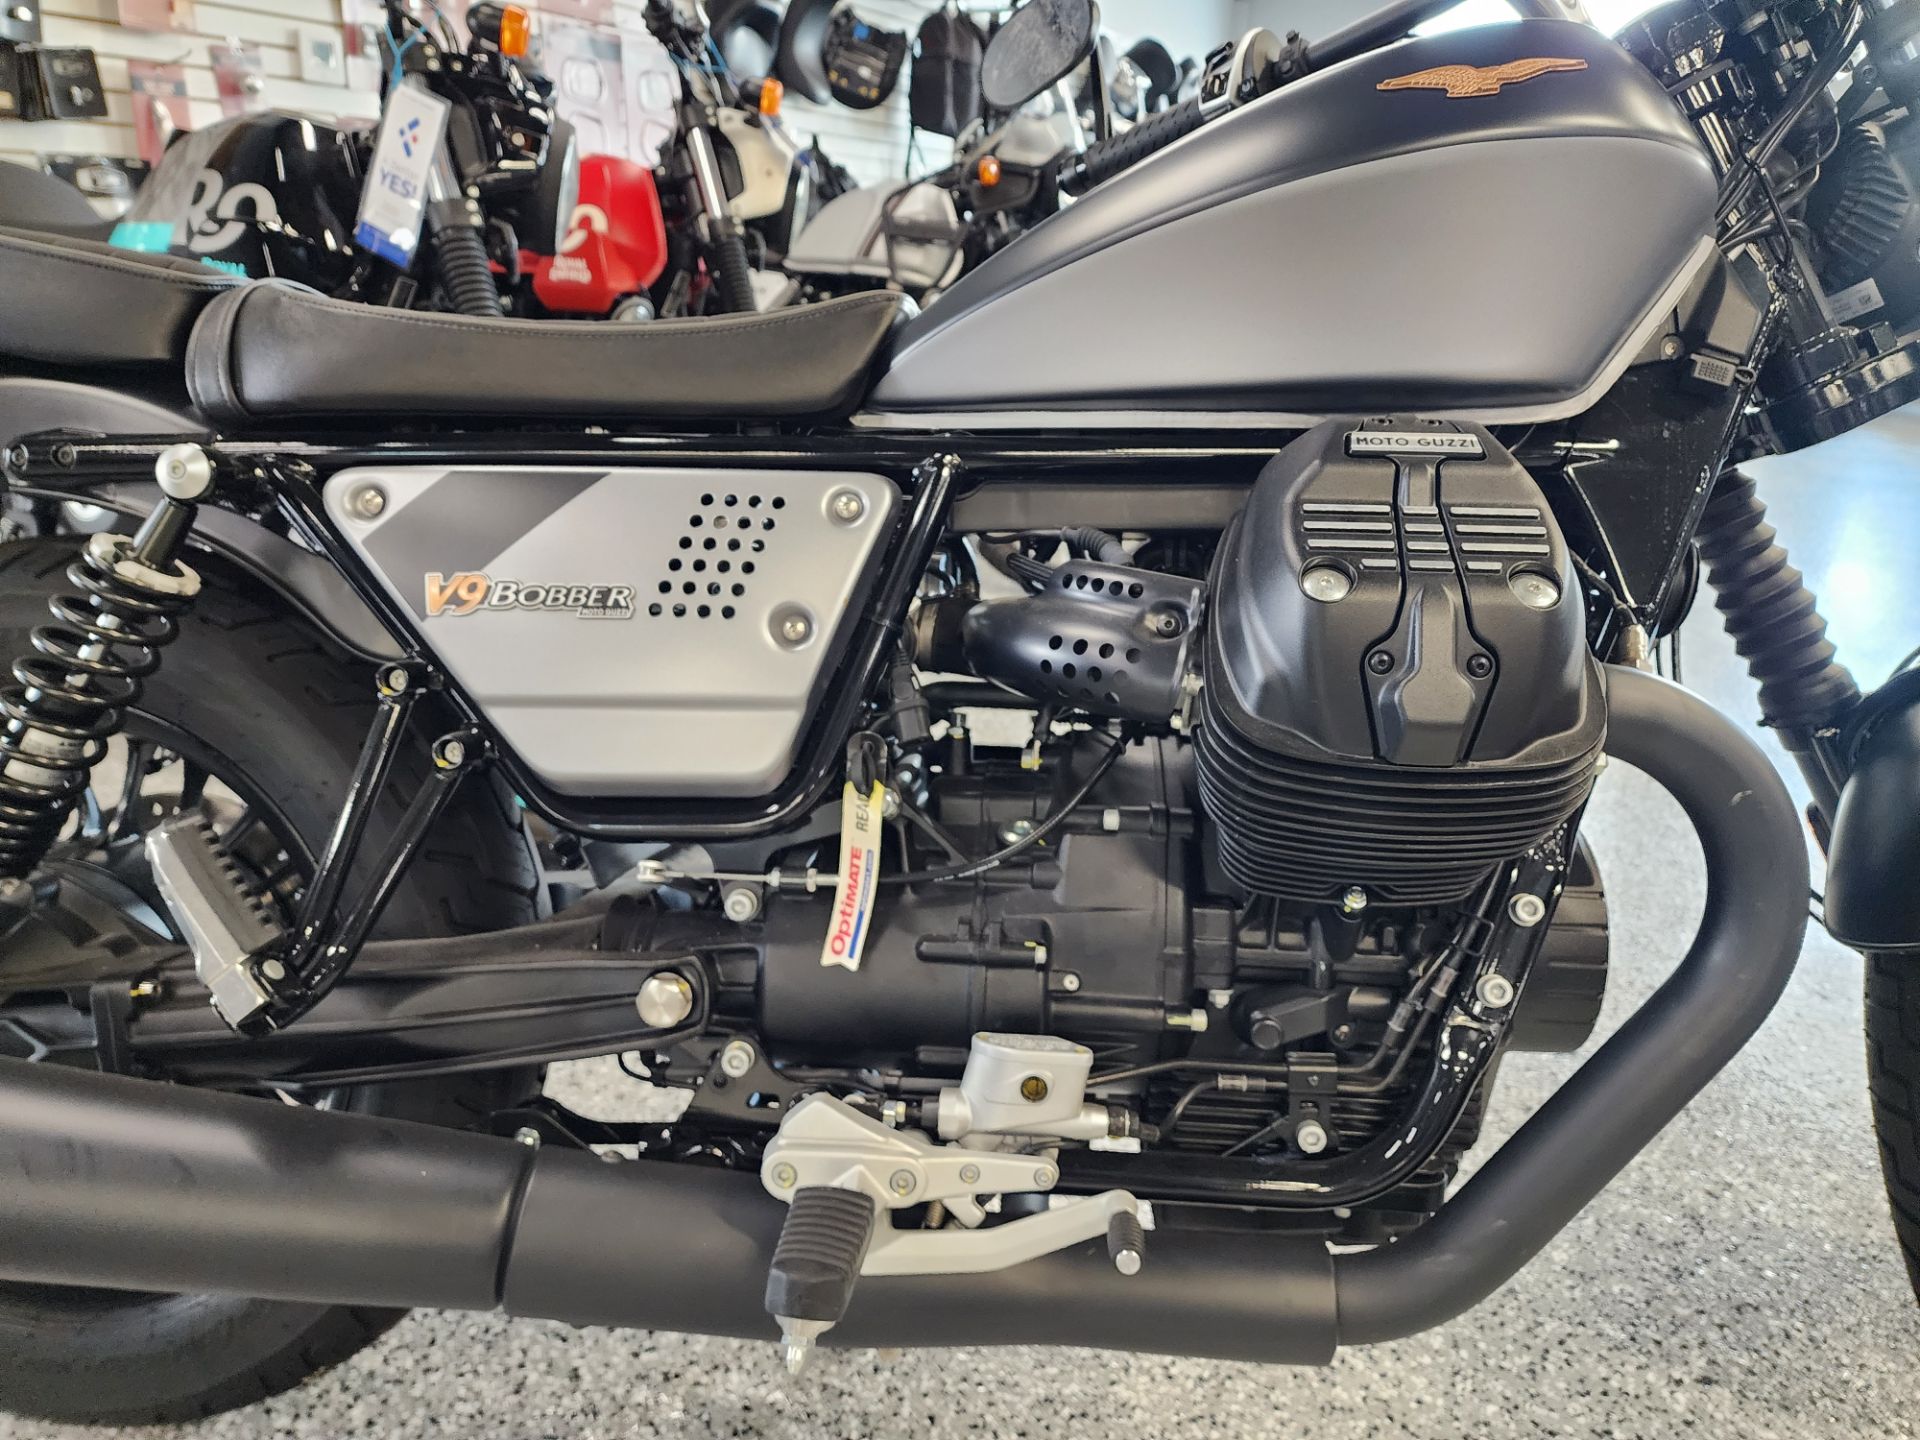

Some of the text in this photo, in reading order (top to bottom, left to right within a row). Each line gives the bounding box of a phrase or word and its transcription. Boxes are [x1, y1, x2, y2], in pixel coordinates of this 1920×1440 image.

[1356, 437, 1475, 448] MOTO GUZZI
[426, 573, 631, 615] V9 BOBBER
[831, 847, 862, 956] OptiMATE
